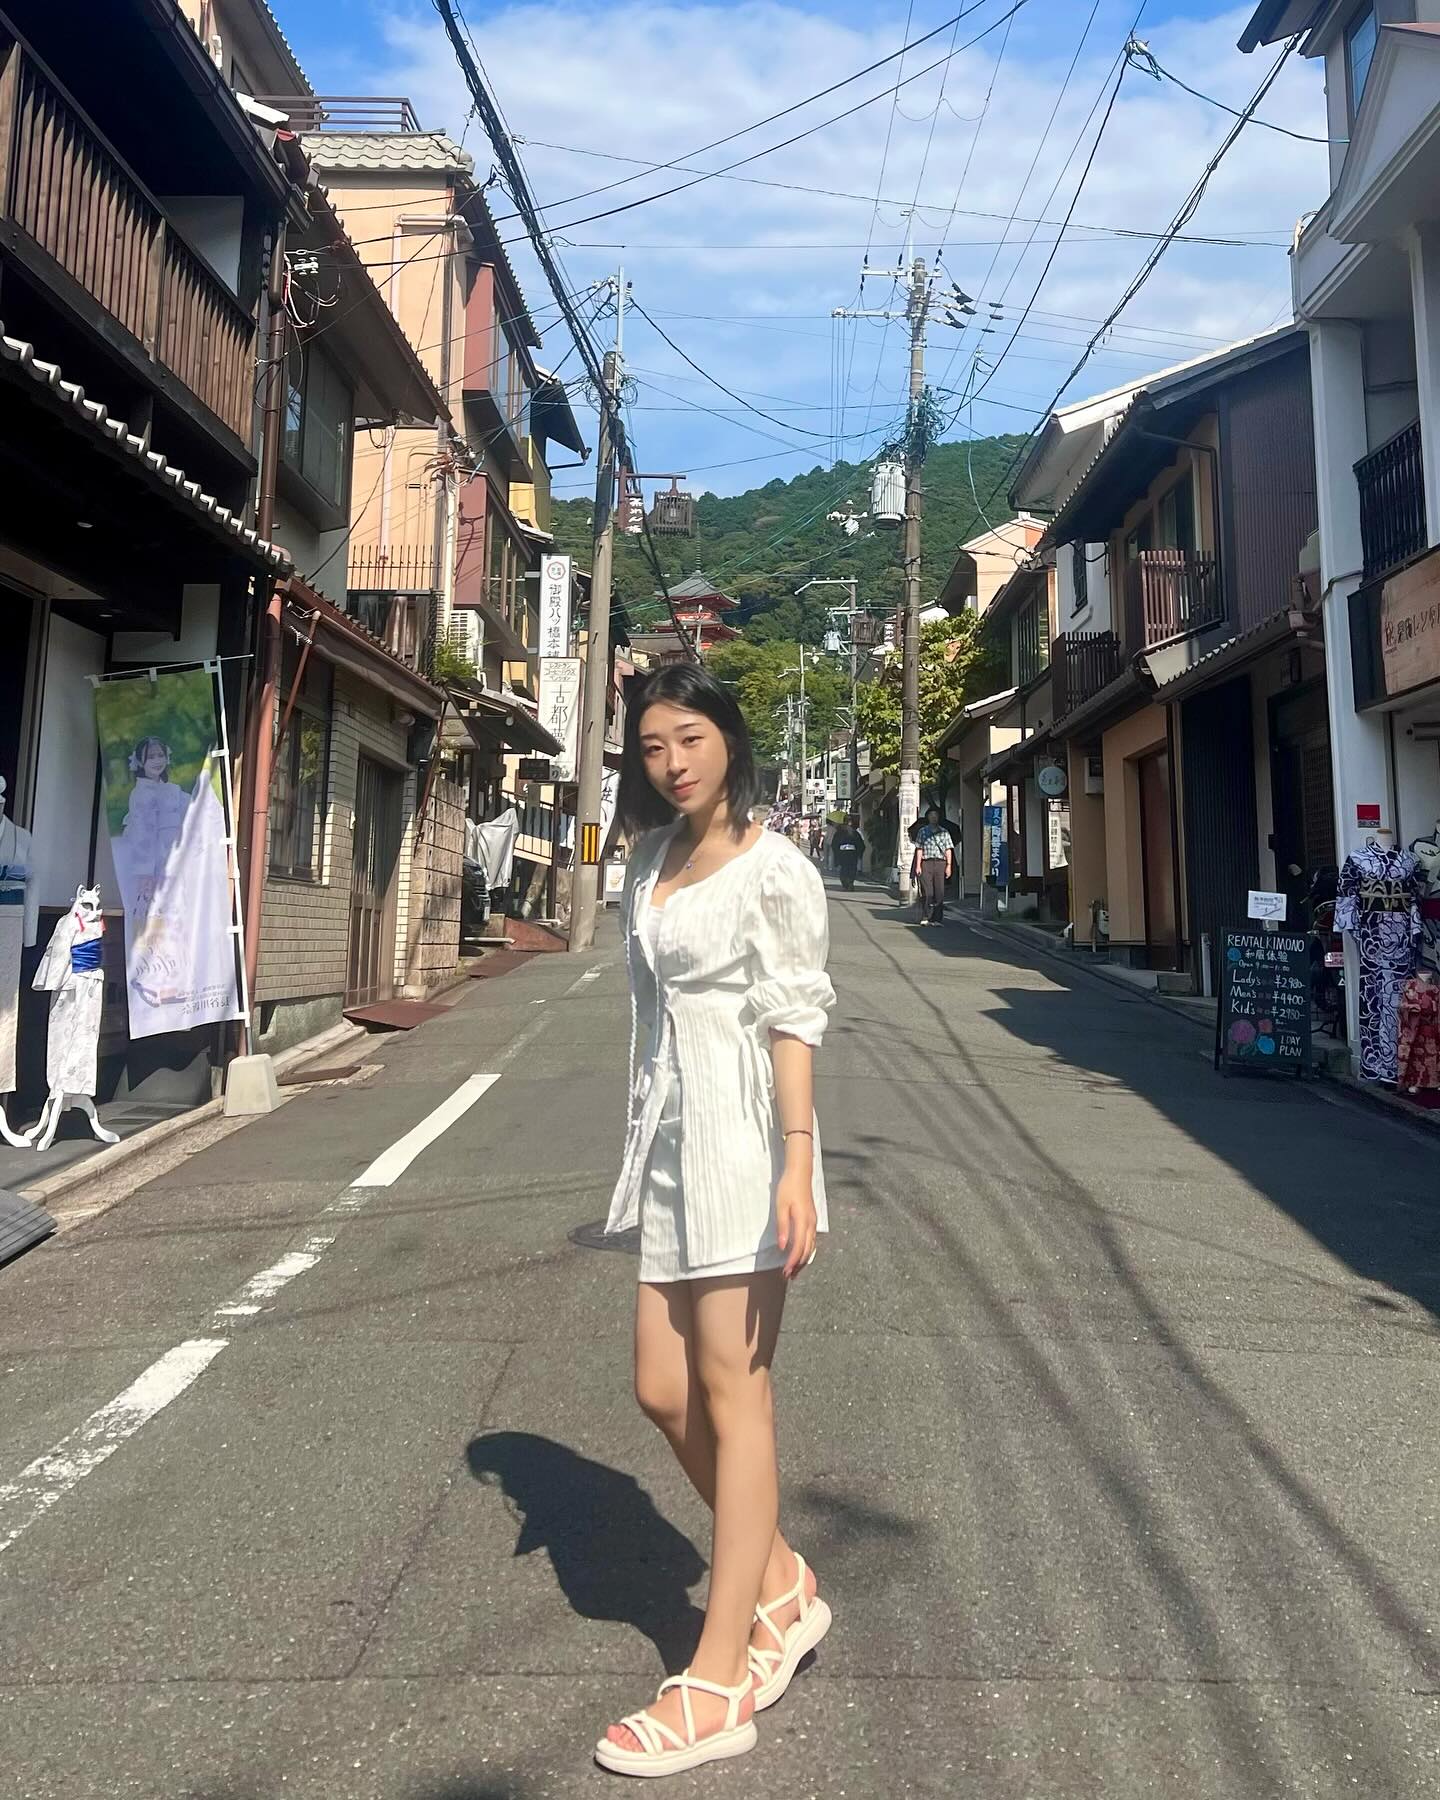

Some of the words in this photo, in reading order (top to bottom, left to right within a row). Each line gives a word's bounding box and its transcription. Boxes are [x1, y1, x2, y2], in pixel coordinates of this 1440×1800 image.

[1227, 934, 1265, 949] RENTAL
[1266, 937, 1304, 952] KIMONO
[1232, 969, 1261, 986] Lady's
[1229, 985, 1257, 998] Men's
[1231, 998, 1256, 1015] Kid's
[1279, 1045, 1302, 1057] PLAN
